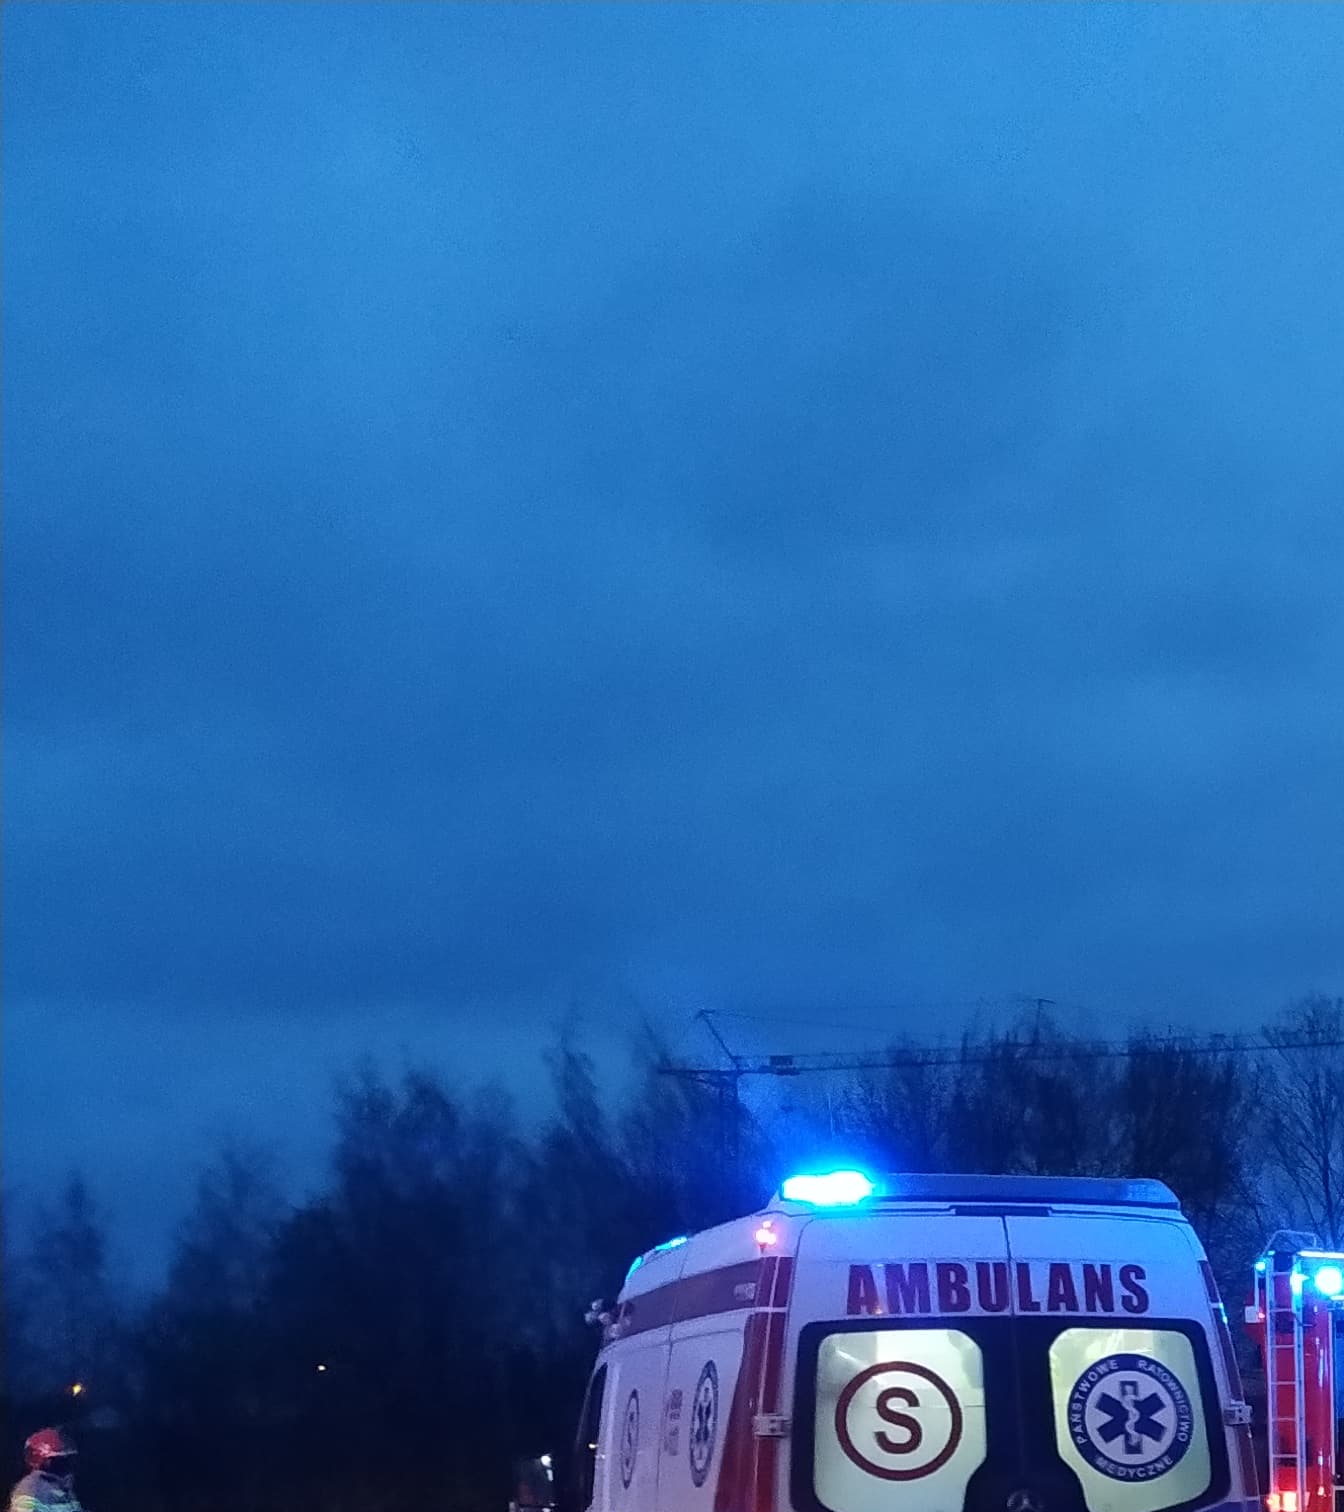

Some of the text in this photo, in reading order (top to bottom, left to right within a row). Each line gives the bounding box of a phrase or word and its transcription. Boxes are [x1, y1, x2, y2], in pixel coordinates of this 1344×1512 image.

[846, 1262, 1149, 1315] AMBULANS
[873, 1387, 923, 1454] S
[1095, 1455, 1173, 1478] MEDYCZNE
